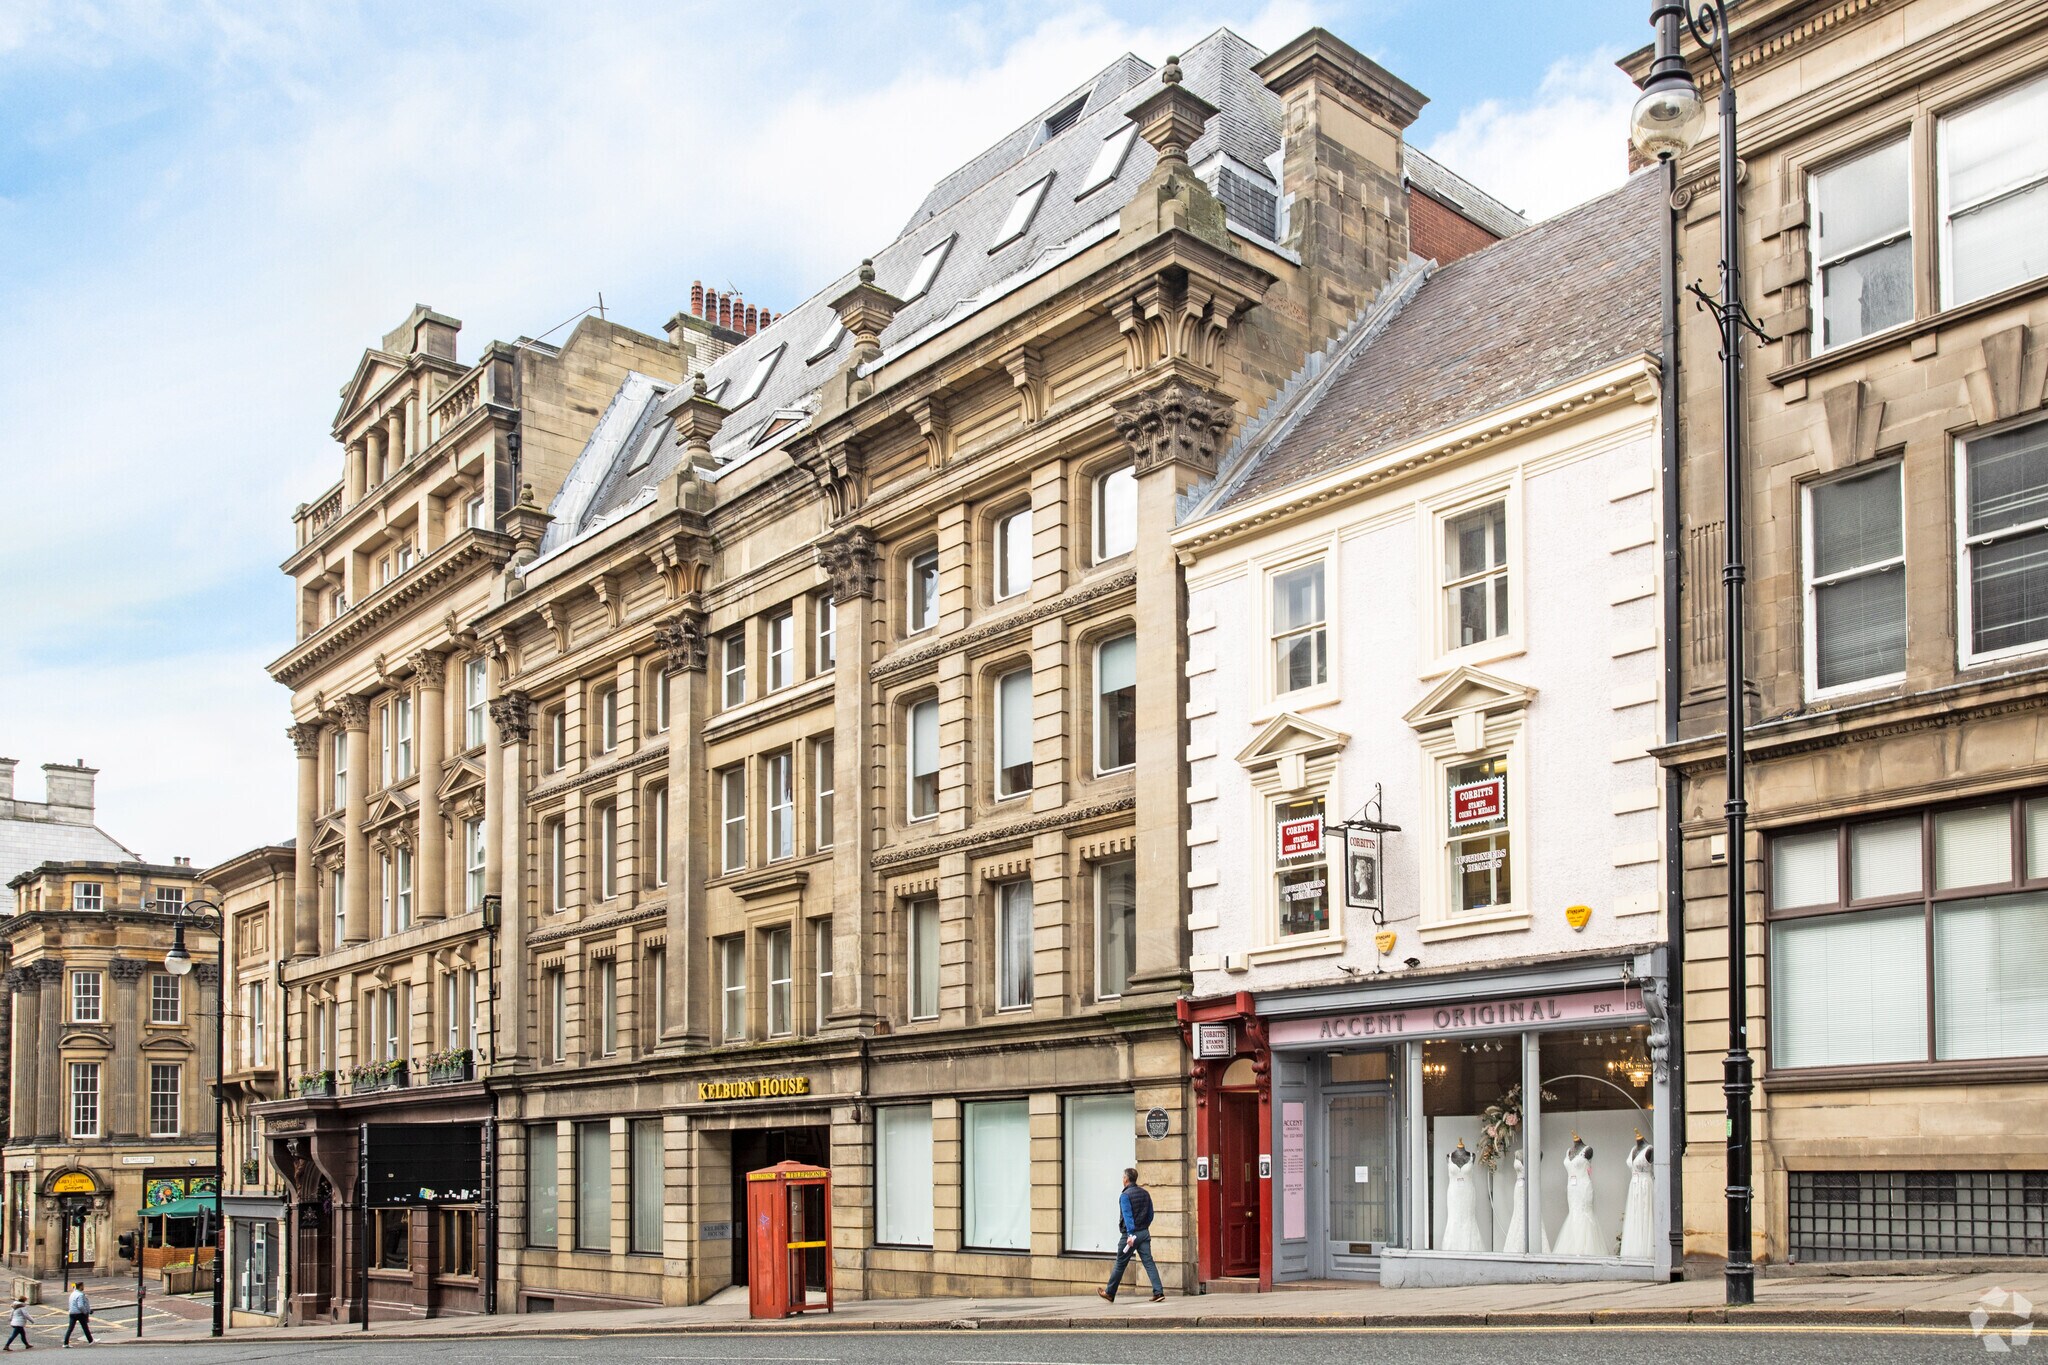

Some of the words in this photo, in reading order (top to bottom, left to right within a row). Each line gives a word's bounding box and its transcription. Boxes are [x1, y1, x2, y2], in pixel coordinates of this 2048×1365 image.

[1460, 787, 1493, 802] CORBITTS
[1468, 800, 1486, 810] STAMPS
[1286, 823, 1314, 836] CORBITTS
[1293, 835, 1308, 844] STAMPS
[1350, 837, 1375, 849] CORBITTS
[1454, 849, 1506, 865] AUCTIONEERS
[1467, 859, 1502, 873] DEALERS
[1282, 879, 1326, 894] AUCTIONEERS
[1292, 889, 1322, 901] DEALERS
[1320, 1014, 1406, 1038] ACCENT
[1434, 1000, 1561, 1029] ORIGINAL
[1593, 1003, 1615, 1014] EST.
[759, 1077, 808, 1097] HOUSE
